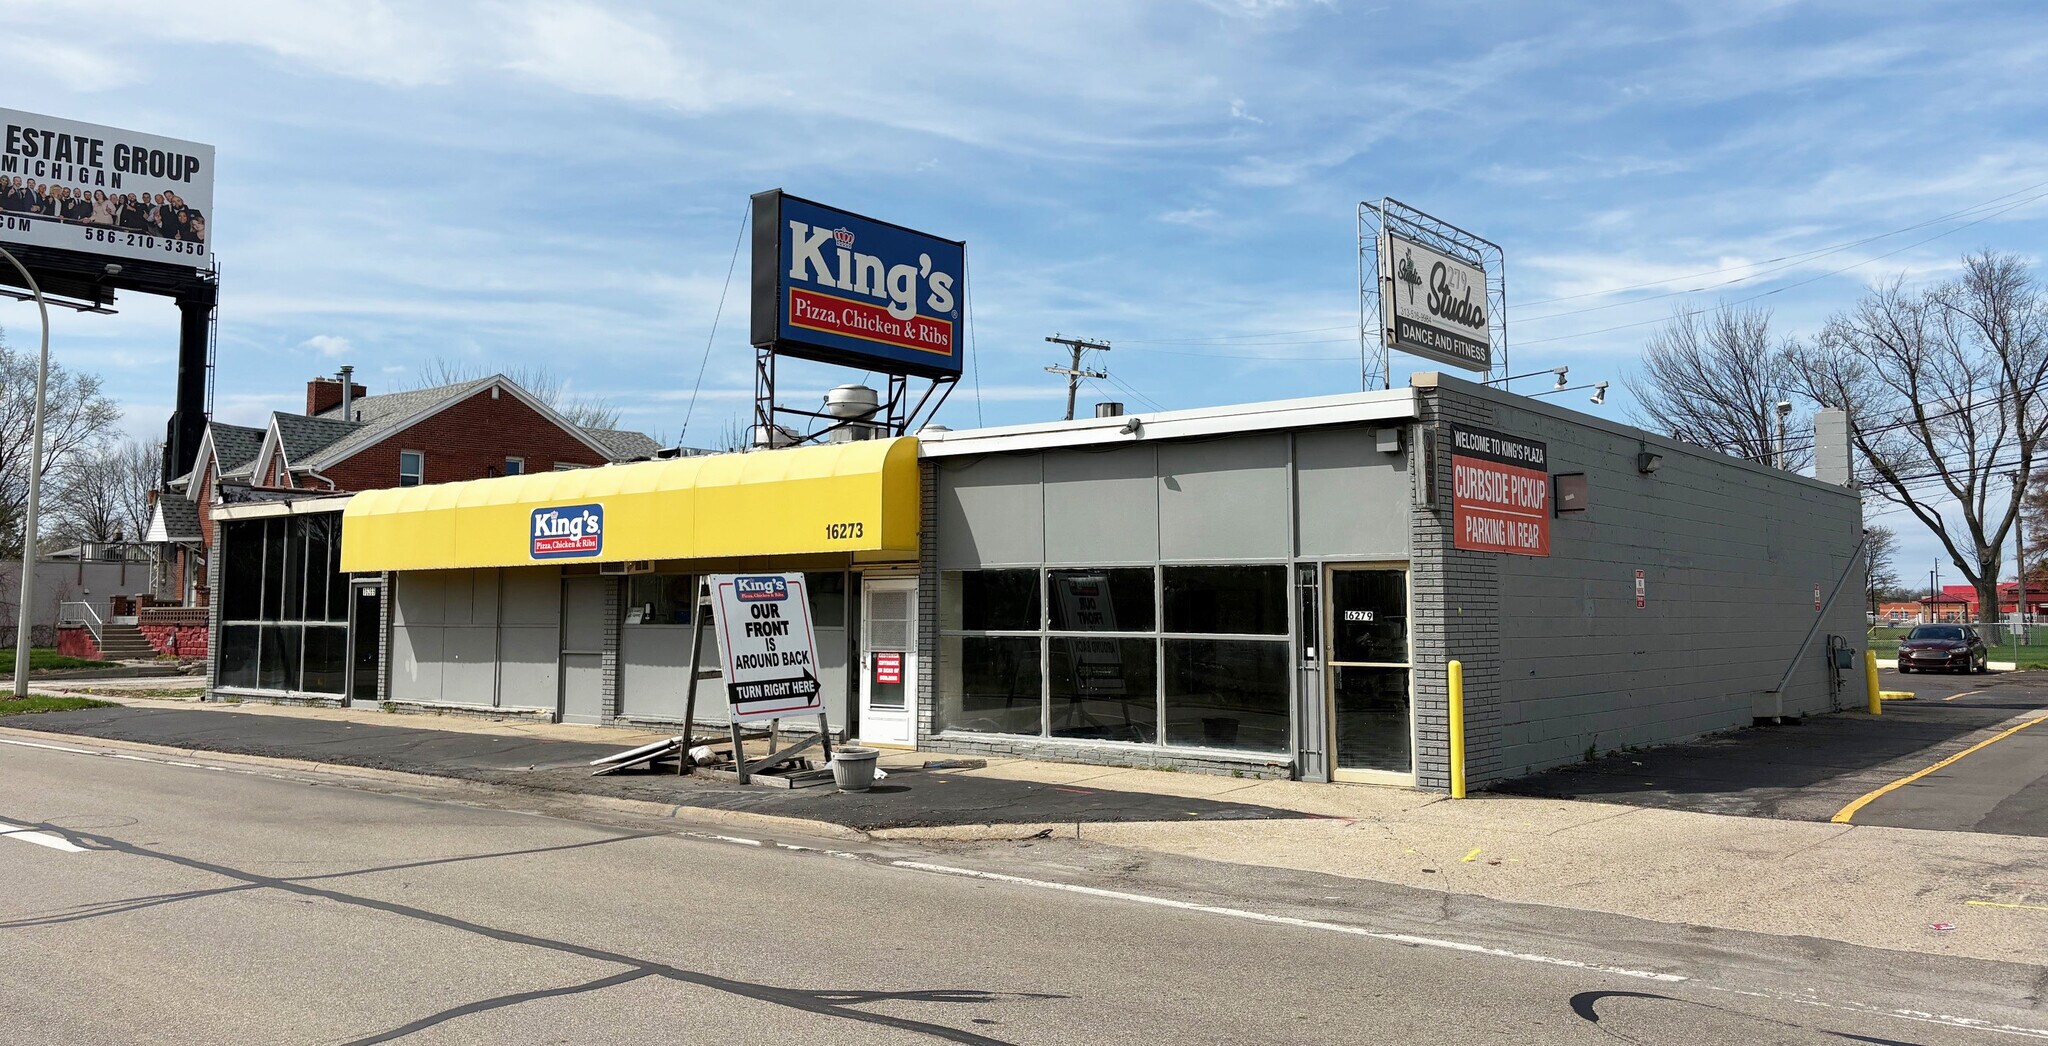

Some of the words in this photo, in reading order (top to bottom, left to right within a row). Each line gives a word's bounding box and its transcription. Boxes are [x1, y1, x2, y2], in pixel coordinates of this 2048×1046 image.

[6, 124, 103, 168] ESTATE
[113, 143, 199, 183] GROUP
[1, 155, 122, 189] MICHIGAN
[85, 228, 204, 256] 586-210-3350
[789, 219, 954, 321] King's
[1427, 261, 1485, 330] Studio
[795, 297, 840, 327] Pizza,
[842, 308, 901, 337] Chicken
[904, 321, 916, 339] &
[919, 324, 948, 346] Ribs
[1402, 323, 1433, 346] DANCE
[1434, 334, 1453, 351] AND
[1453, 340, 1486, 361] FITNESS
[1454, 431, 1490, 453] WELCOME
[1491, 438, 1500, 455] TO
[1501, 441, 1523, 460] KING'S
[1523, 446, 1544, 464] PLAZA
[1455, 465, 1509, 504] CURBSIDE
[1511, 475, 1546, 509] PICKUP
[534, 510, 599, 541] King's
[825, 522, 864, 540] 16273
[1465, 515, 1506, 545] PARKING
[1507, 521, 1516, 546] IN
[1518, 522, 1539, 549] REAR
[552, 540, 575, 549] Chicken
[582, 539, 596, 547] Ribs
[737, 578, 784, 594] King's
[751, 603, 780, 619] OUR
[1345, 611, 1373, 621] 16279
[745, 620, 789, 637] FRONT
[765, 637, 776, 652] IS
[736, 652, 779, 670] AROUND
[782, 650, 810, 666] BACK
[736, 685, 763, 699] TURN
[764, 684, 790, 698] RIGHT
[792, 680, 816, 694] HERE
